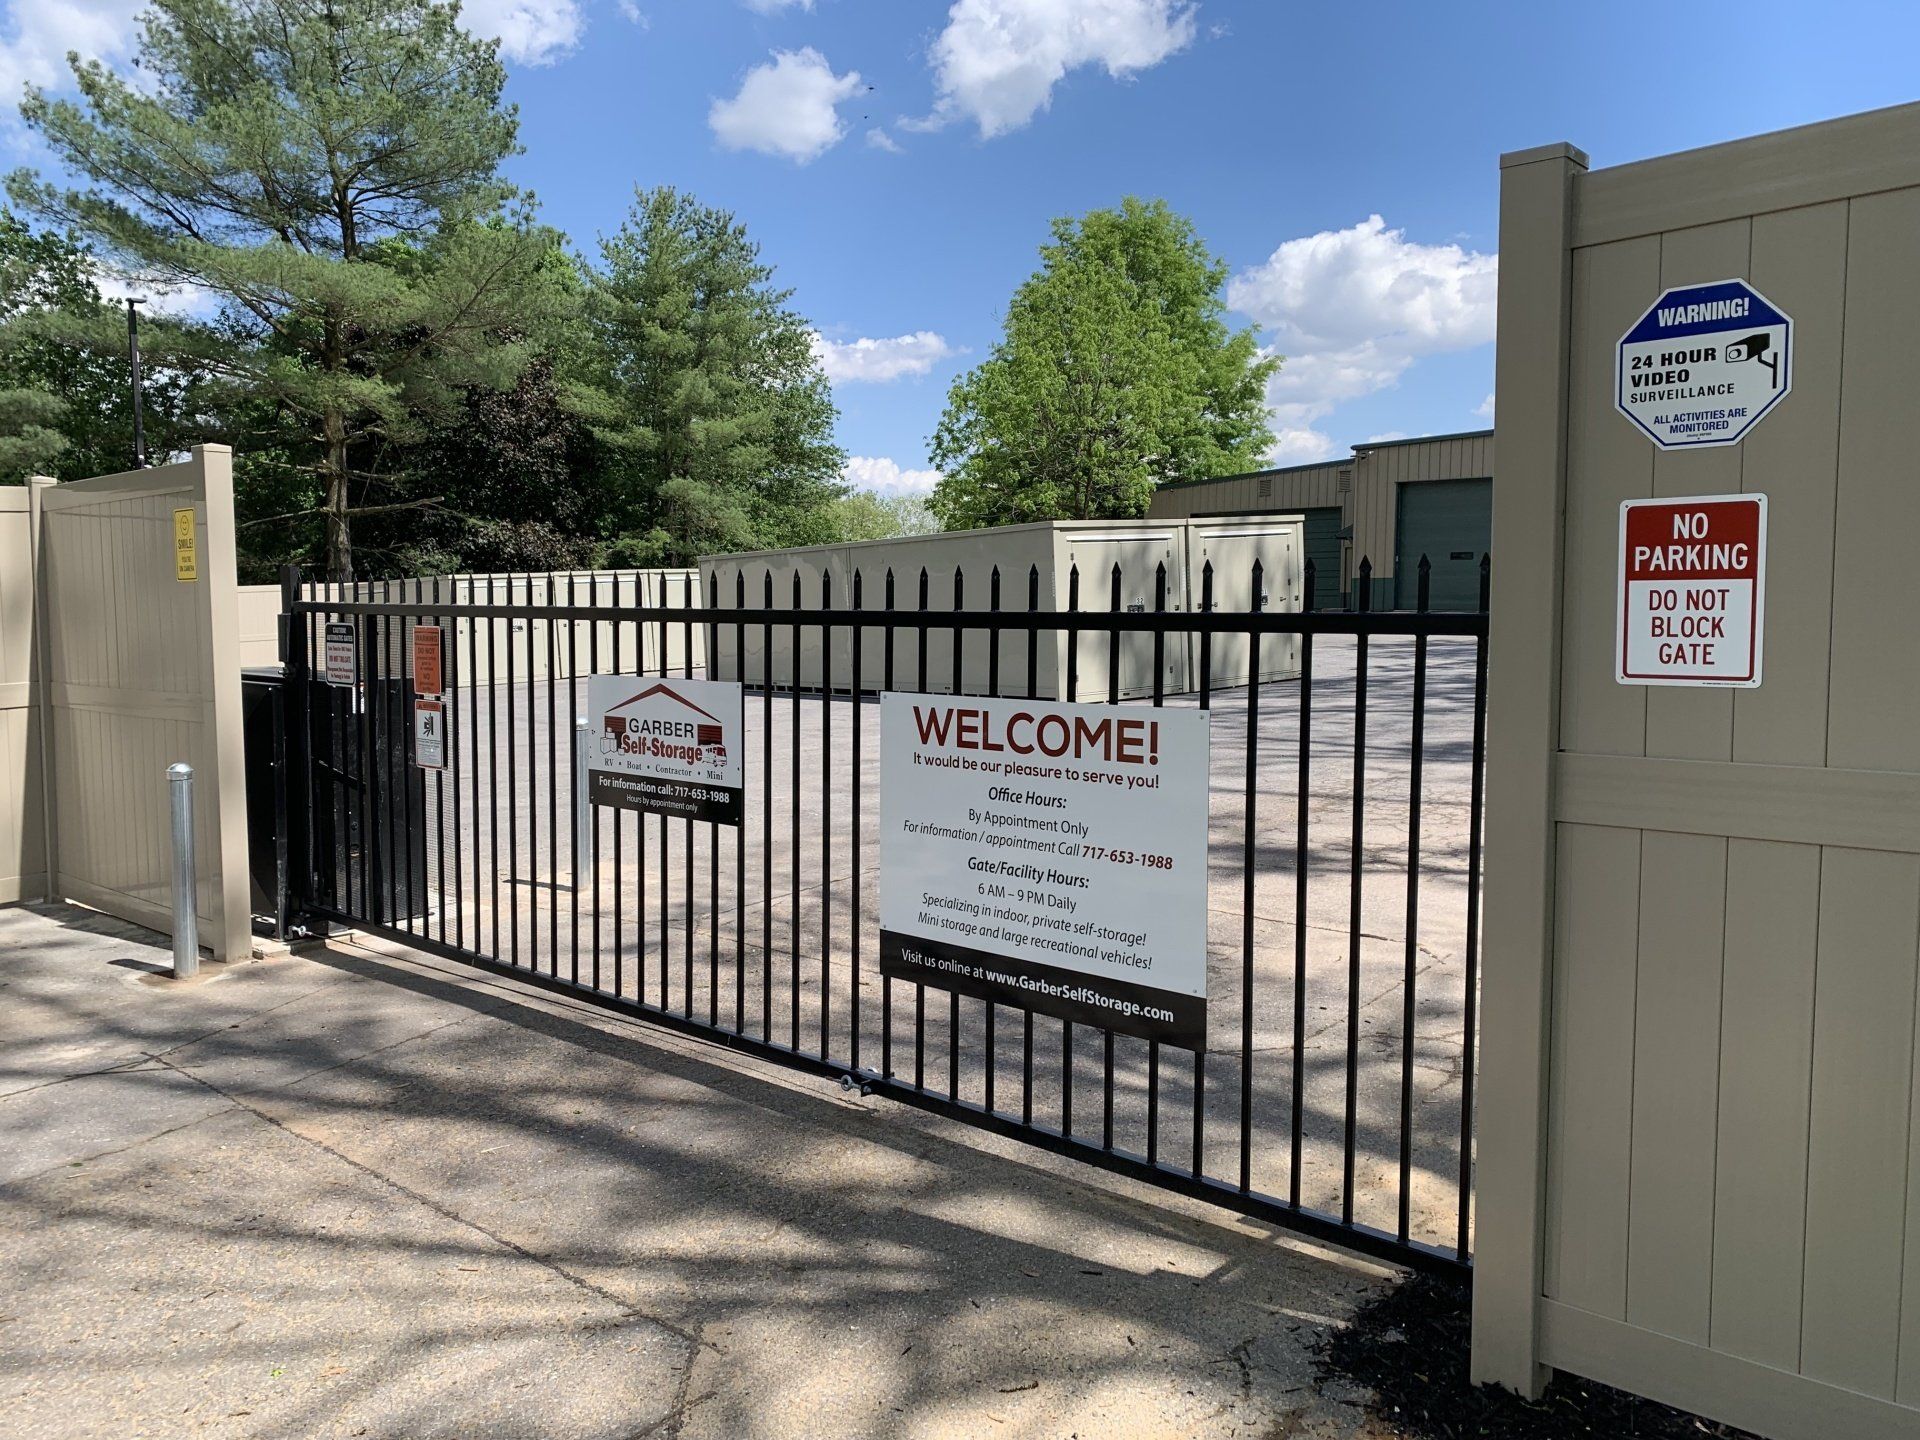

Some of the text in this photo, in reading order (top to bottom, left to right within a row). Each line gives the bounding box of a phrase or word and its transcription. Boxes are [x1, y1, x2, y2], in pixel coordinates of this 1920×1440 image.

[1658, 297, 1750, 328] WARNING!
[1631, 347, 1717, 370] 24 HOUR
[1630, 368, 1690, 388] VIDEO
[1630, 383, 1735, 404] SURVEILLANCE
[1654, 407, 1748, 425] ALL ACTIVITIES ARE
[1669, 420, 1729, 434] MONITORED
[1673, 512, 1709, 540] NO
[1634, 543, 1749, 572] PARKING
[1648, 589, 1730, 611] DO NOT
[1651, 616, 1725, 638] BLOCK
[1658, 643, 1715, 665] GATE
[629, 718, 694, 738] GARBER
[912, 705, 1159, 766] WELCOME!
[622, 734, 703, 766] Self-Storage
[604, 758, 723, 781] RV Boat Contractor Mini
[913, 752, 1160, 790] It would be our pleasure to serve you!
[598, 776, 730, 804] For information call: 717-653-1988
[626, 794, 698, 813] Hours by appointment only
[988, 786, 1067, 808] Office Hours:
[968, 808, 1089, 839] By Appointment Only
[904, 820, 918, 832] For
[920, 822, 978, 842] information
[986, 834, 1056, 854] appointment
[1058, 842, 1080, 856] Call
[1082, 845, 1173, 870] 717-653-1988
[968, 856, 1090, 889] Gate/Facility Hours:
[978, 882, 985, 894] 6
[987, 884, 1006, 898] AM
[1017, 889, 1024, 902] 9
[1027, 890, 1045, 906] PM
[1048, 894, 1076, 914] Daily
[922, 892, 1147, 948] Specializing in indoor, private self-storage!
[918, 912, 1153, 970] Mini storage and large recreational vehicles!
[902, 948, 1174, 1022] Visit us online at www.GarberSelfStorage.com
